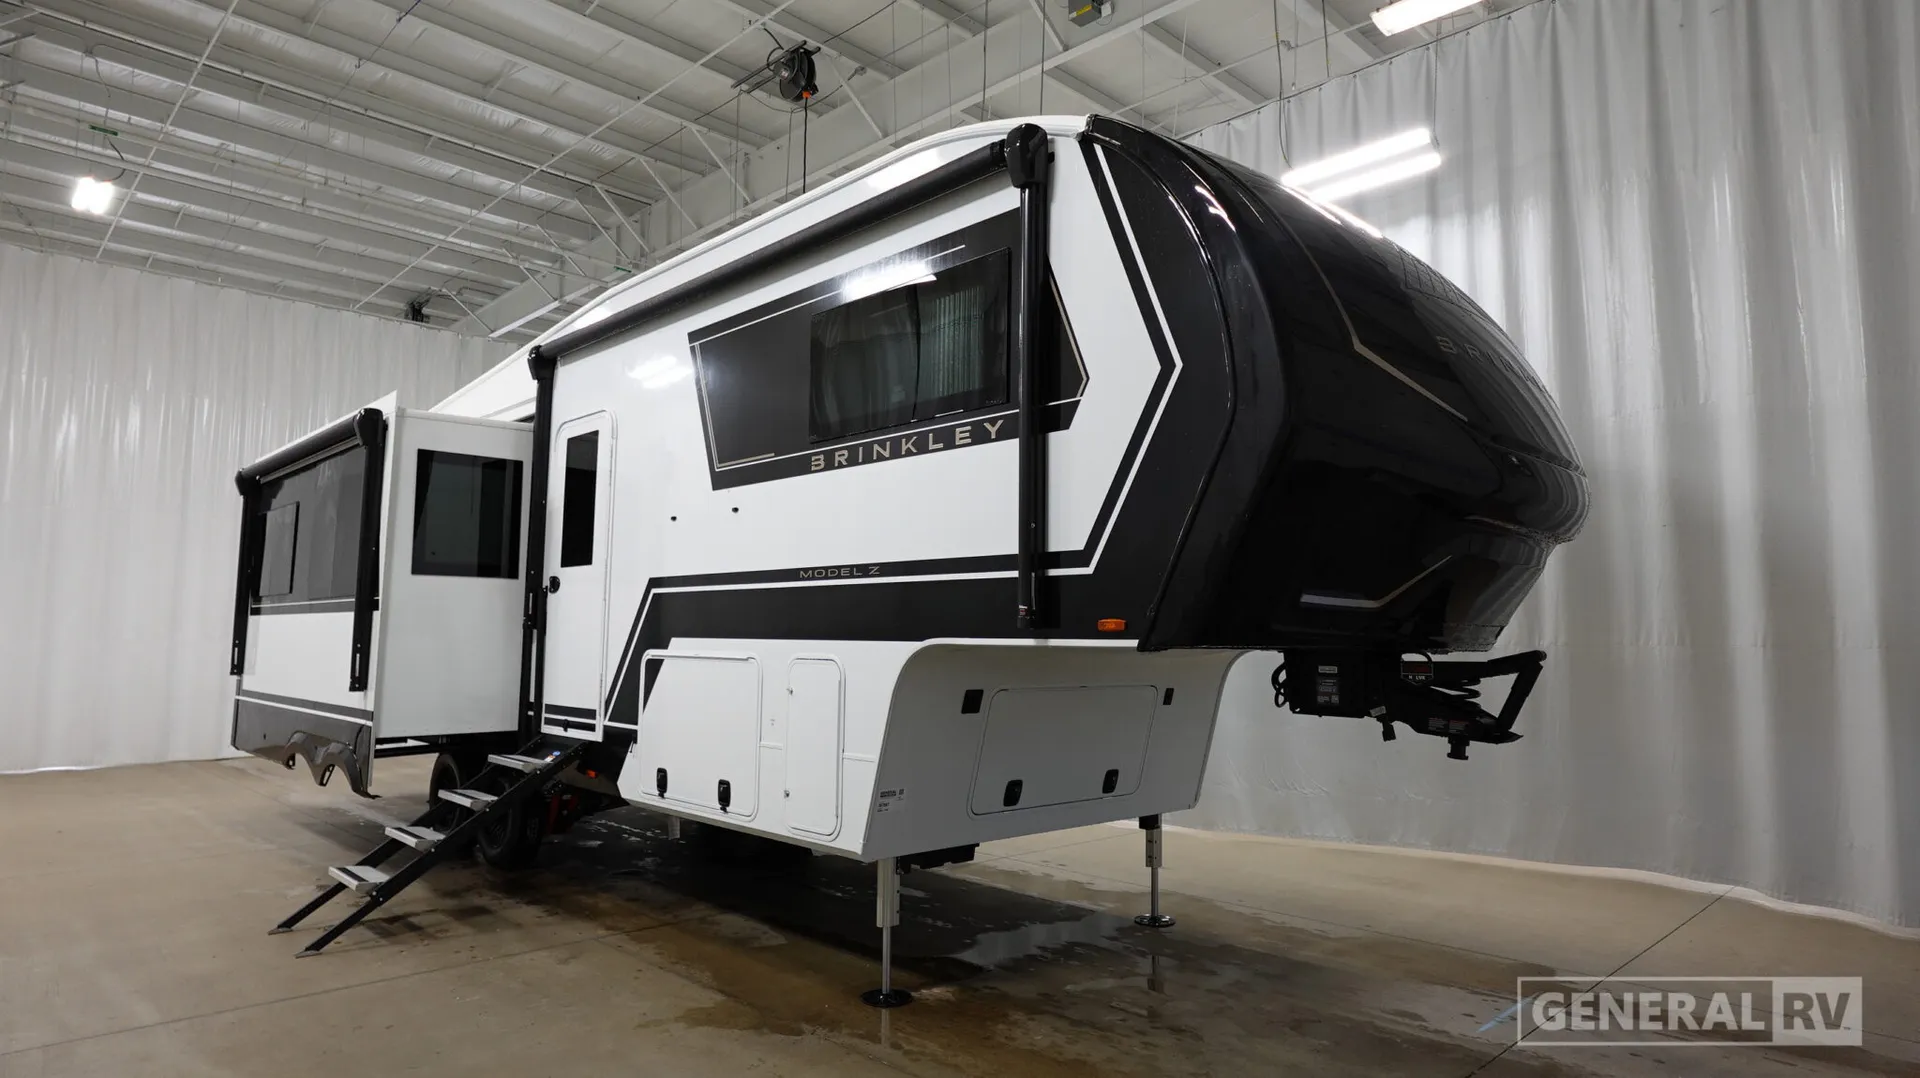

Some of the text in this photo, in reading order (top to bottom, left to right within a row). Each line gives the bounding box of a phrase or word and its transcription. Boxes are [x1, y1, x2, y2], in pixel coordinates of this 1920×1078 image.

[811, 419, 1004, 471] BRINKLEY
[799, 565, 880, 579] MODEL Z
